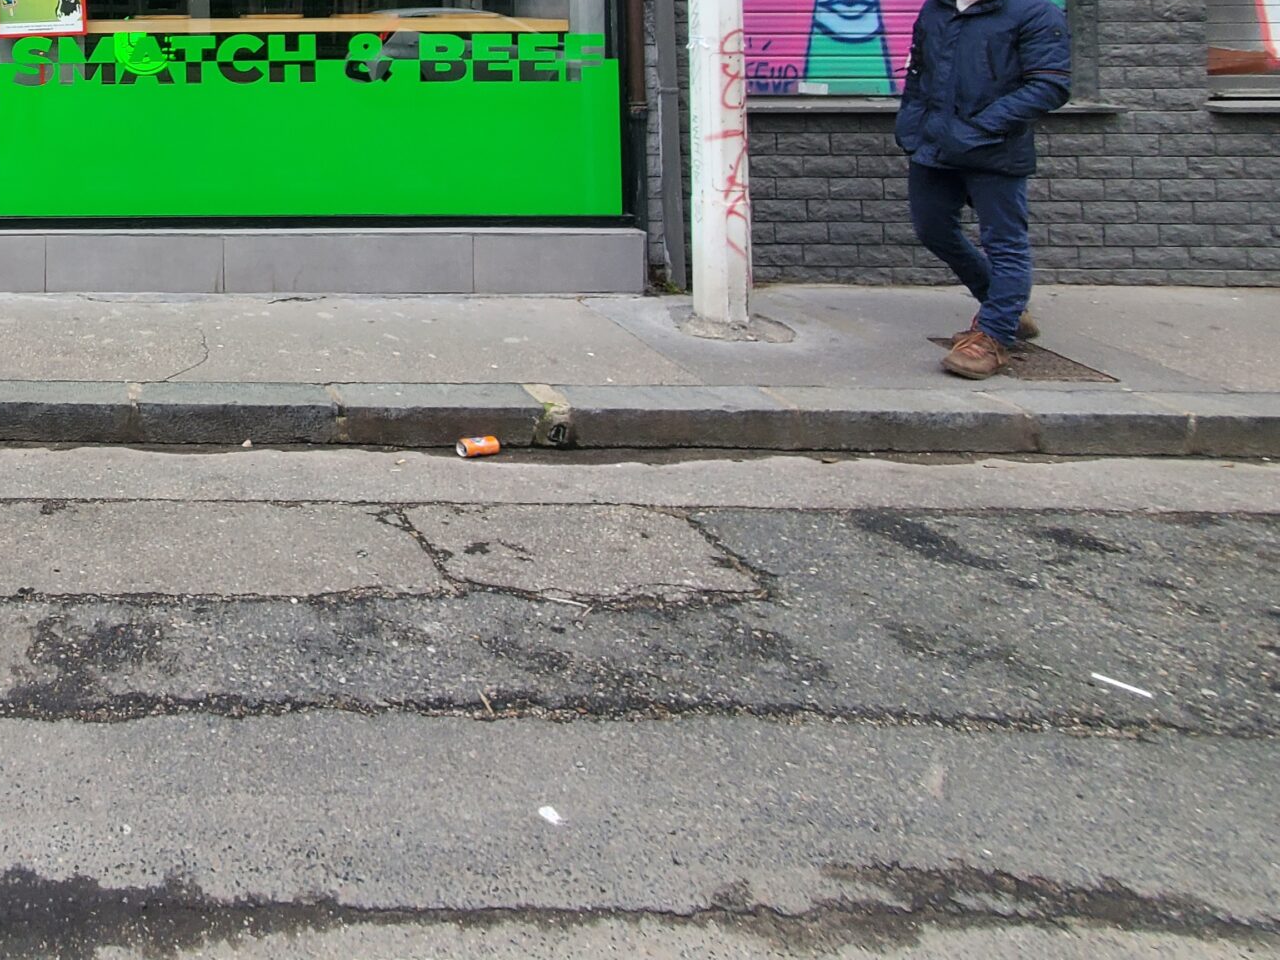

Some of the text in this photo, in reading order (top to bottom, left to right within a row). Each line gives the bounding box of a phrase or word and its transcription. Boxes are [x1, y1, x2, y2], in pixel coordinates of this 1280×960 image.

[12, 33, 605, 86] SMATCH & BEEF
